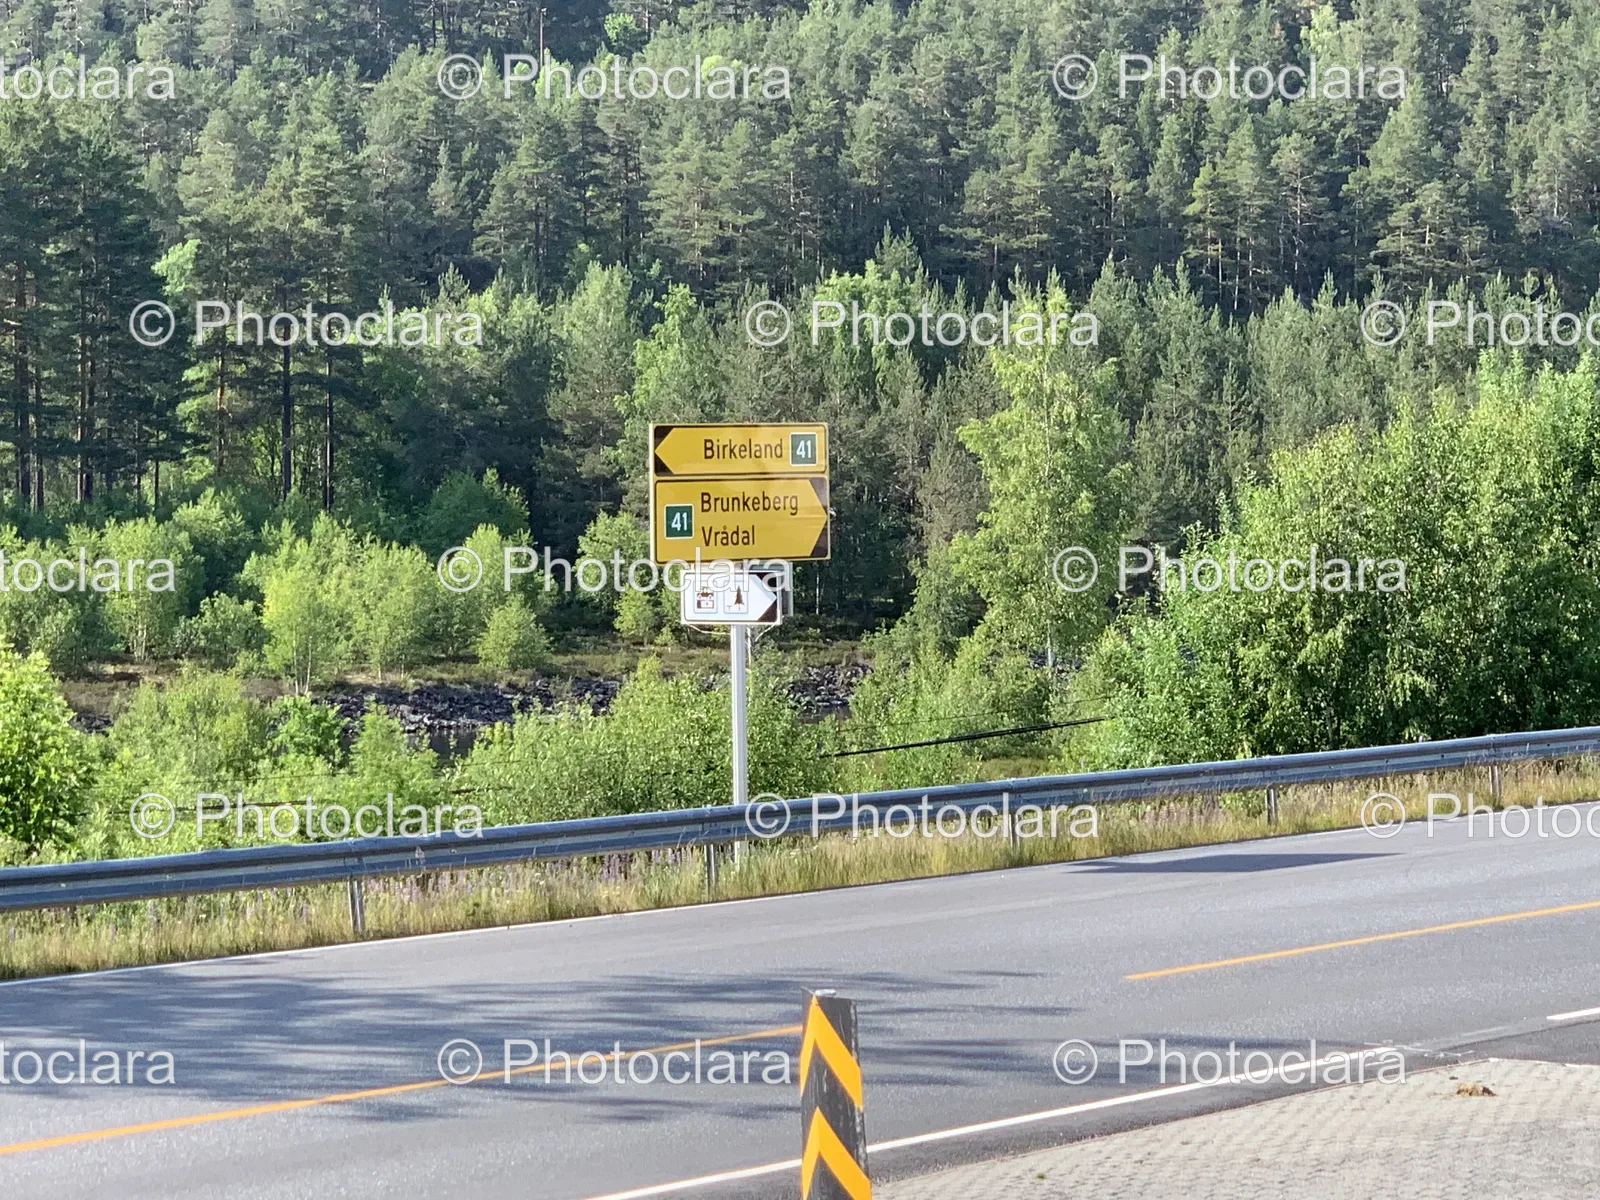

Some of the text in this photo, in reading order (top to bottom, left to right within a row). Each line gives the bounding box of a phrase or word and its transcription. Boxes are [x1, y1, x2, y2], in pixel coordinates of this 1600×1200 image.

[703, 438, 812, 460] Birkeland 41
[701, 491, 798, 516] Brunkeberg
[671, 512, 688, 531] 41
[702, 525, 755, 547] Vrådal
